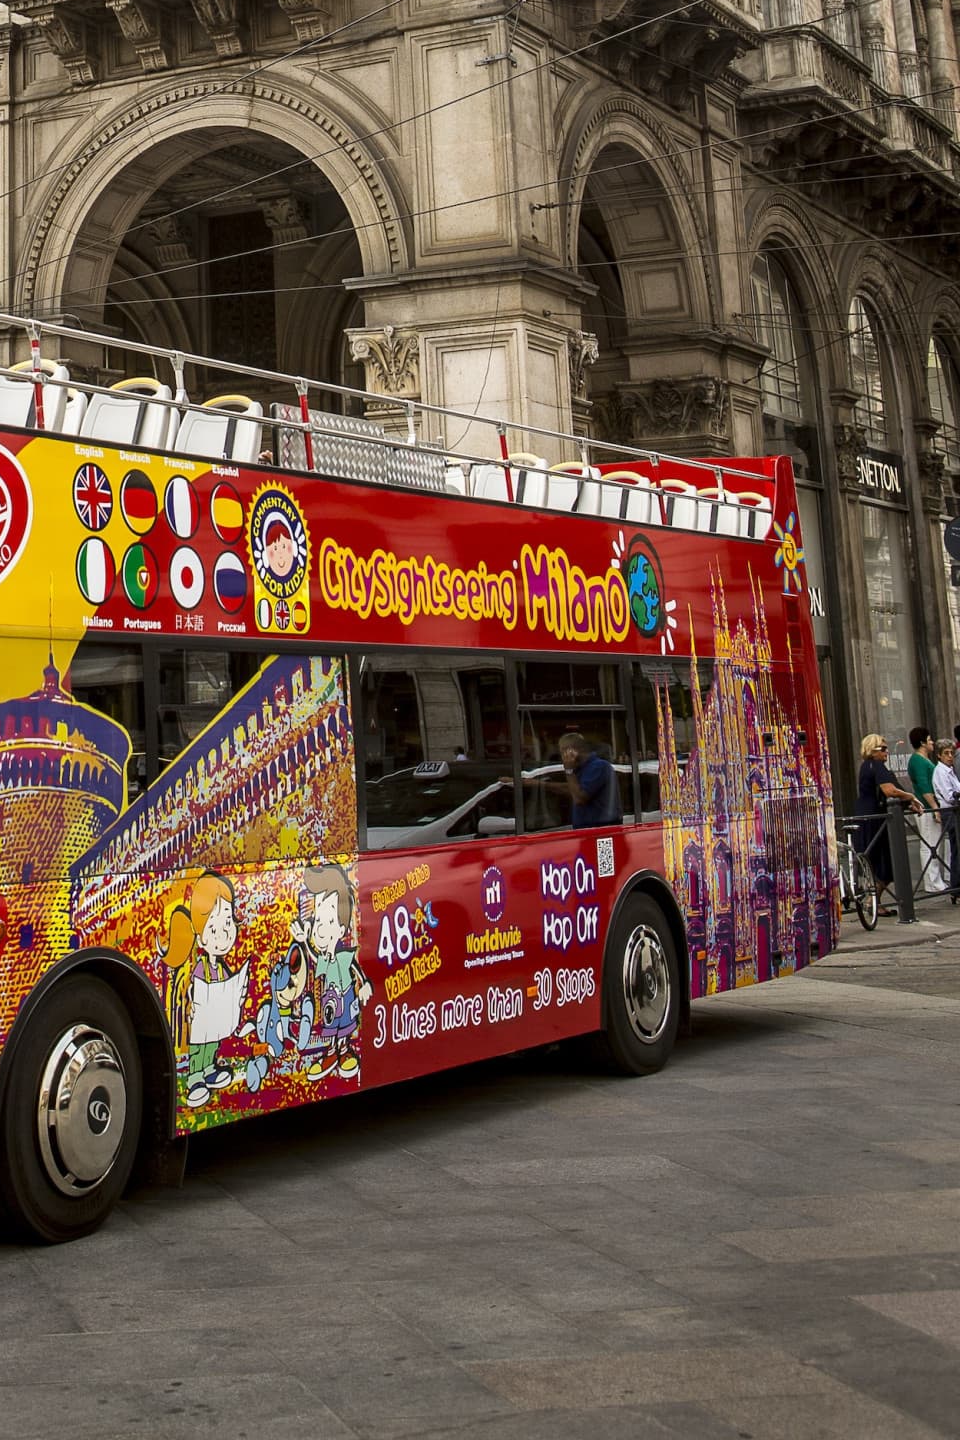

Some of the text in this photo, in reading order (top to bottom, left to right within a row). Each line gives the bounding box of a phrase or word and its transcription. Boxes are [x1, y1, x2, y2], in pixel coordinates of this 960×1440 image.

[74, 445, 105, 458] English
[119, 450, 152, 464] Deutsch
[164, 457, 196, 471] Français
[211, 463, 240, 478] Español
[253, 496, 297, 537] COMMENTARY
[263, 565, 304, 597] FOR KIDS
[320, 537, 631, 643] CitySightseeing Milano
[83, 616, 114, 628] Italiano
[124, 617, 162, 631] Portugues
[175, 613, 204, 632] 日本語
[372, 864, 431, 912] Biglietto Valido
[542, 858, 596, 901] Hop On
[378, 906, 413, 965] 48
[466, 925, 522, 953] Worldwide
[544, 906, 599, 951] Hop Off
[385, 945, 442, 1001] Valid Ticket
[373, 967, 596, 1049] 3 Lines more than 30 Stops
